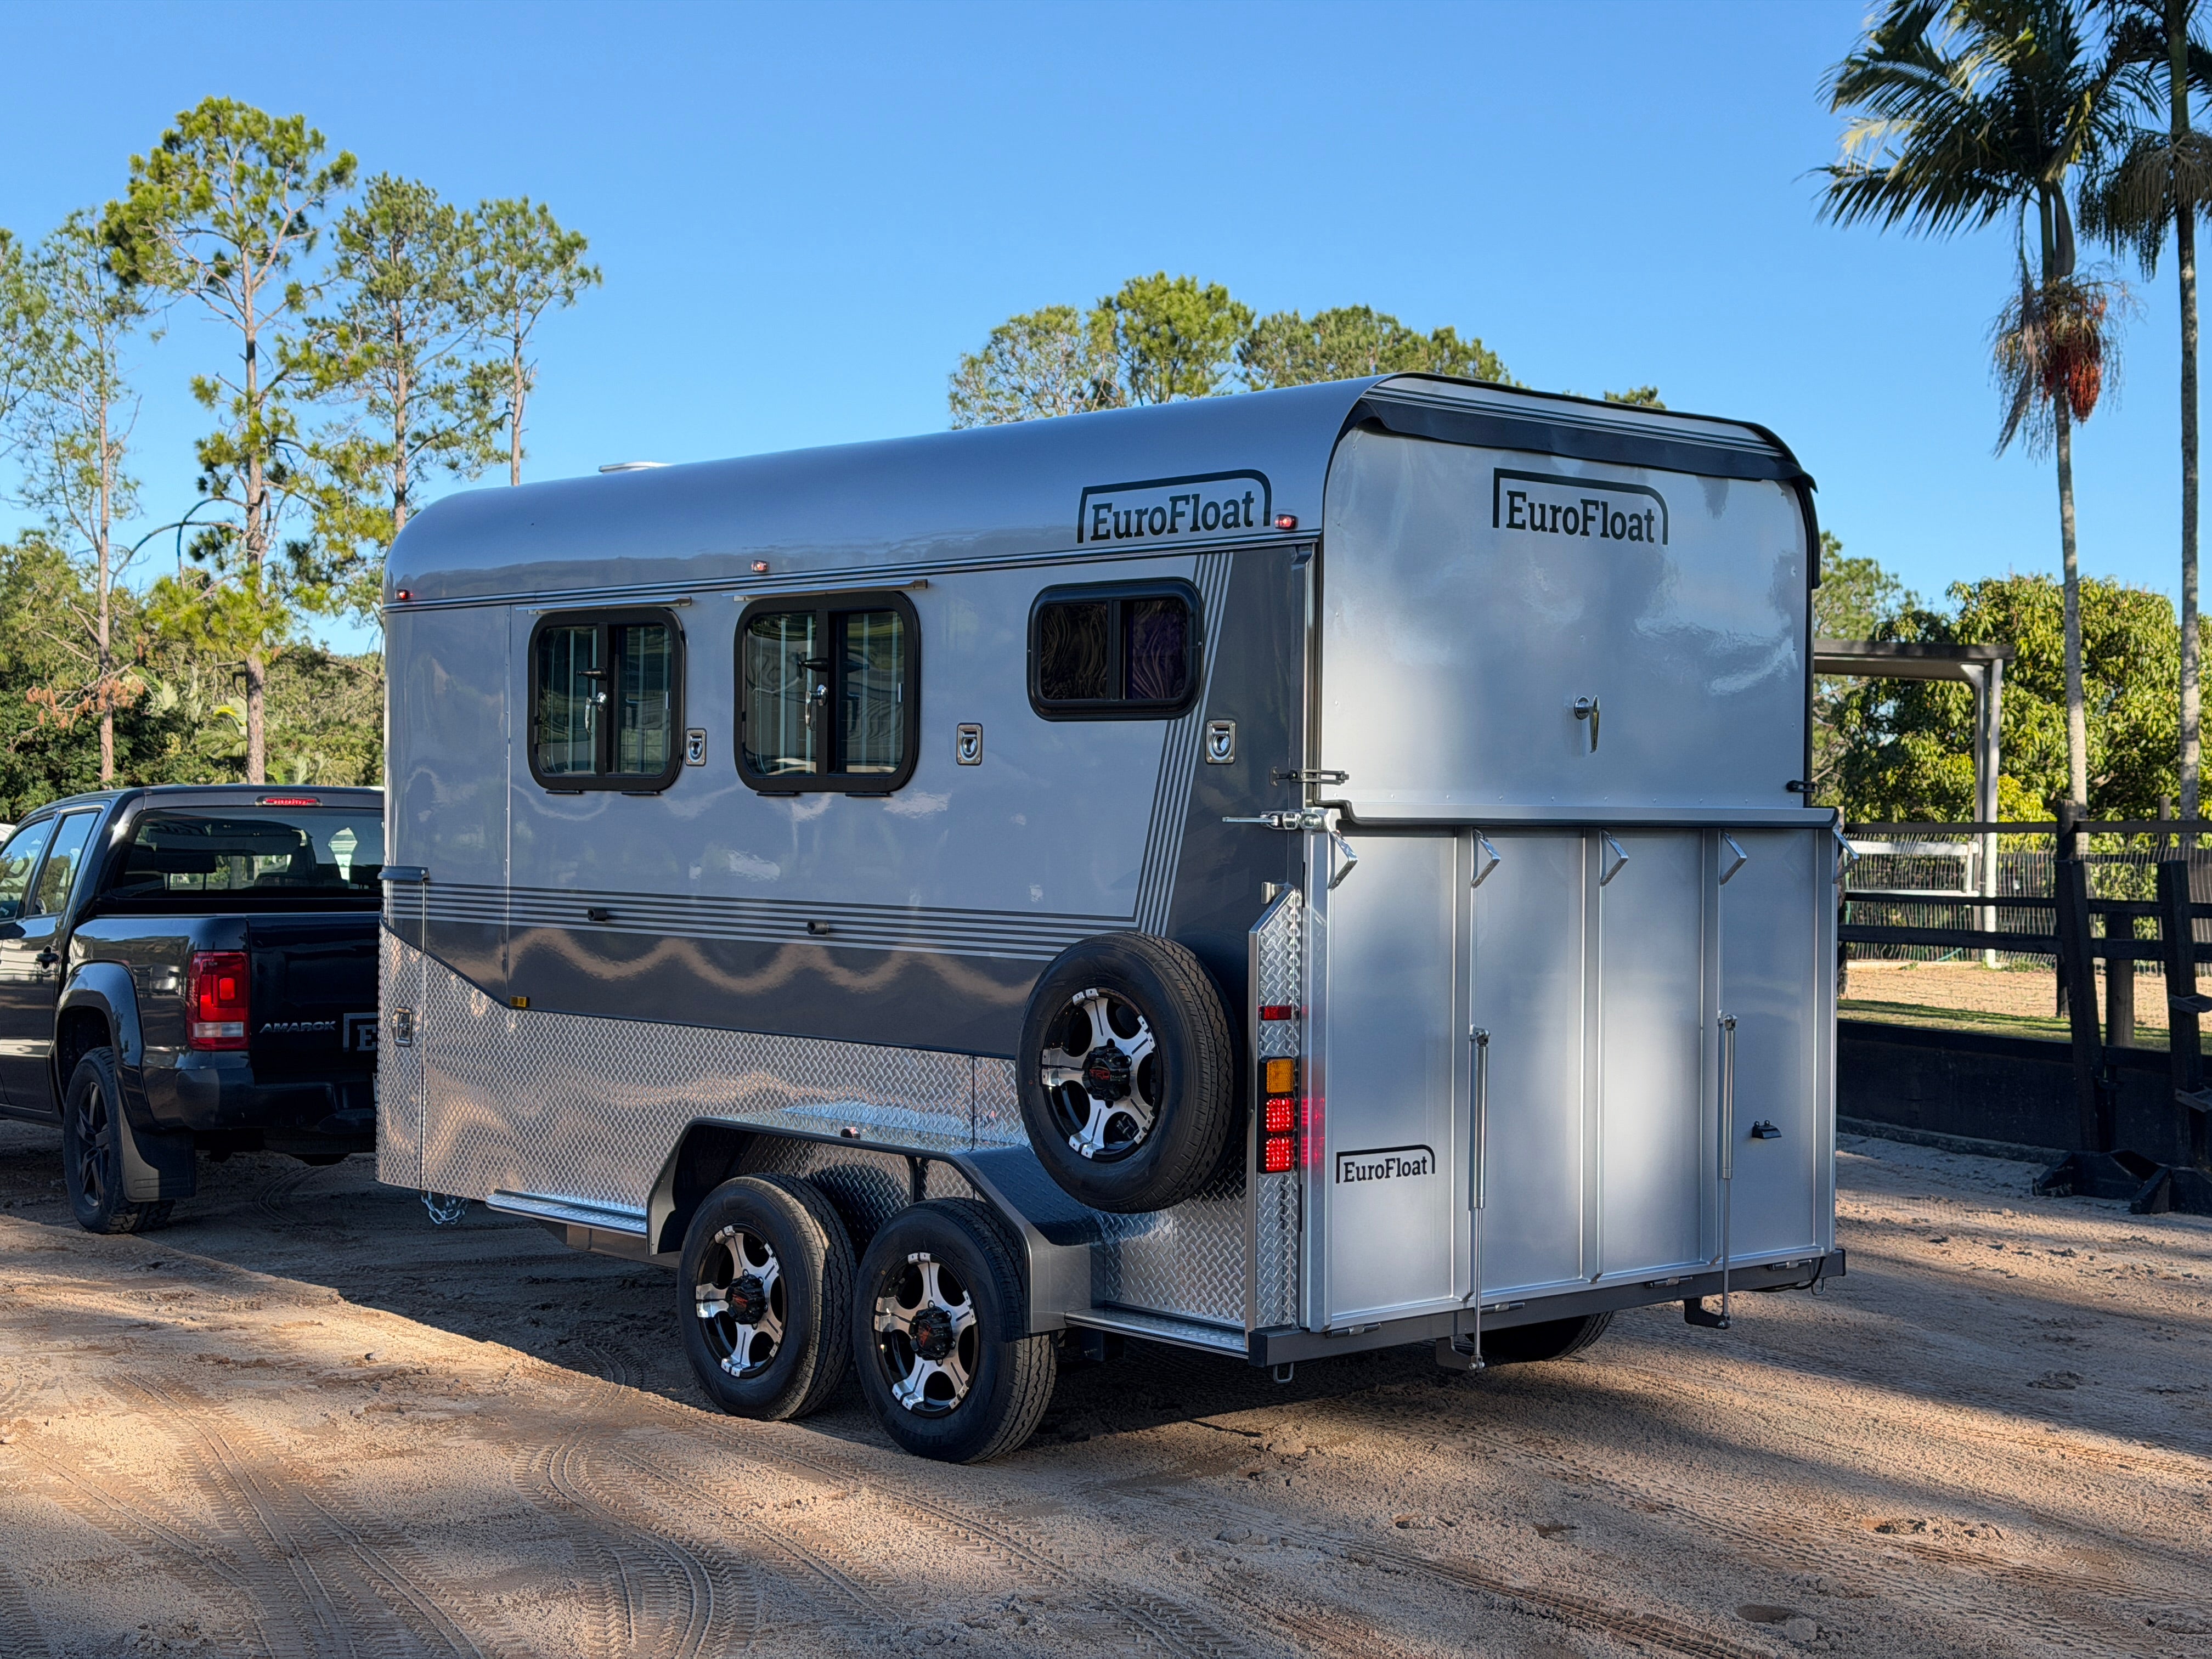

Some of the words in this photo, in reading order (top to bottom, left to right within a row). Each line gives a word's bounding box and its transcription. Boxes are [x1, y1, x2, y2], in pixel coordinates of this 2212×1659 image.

[1090, 491, 1255, 541] EuroFloat
[1506, 490, 1655, 543] EuroFloat
[259, 1020, 336, 1034] AMAROK
[1343, 1156, 1427, 1183] EuroFloat
